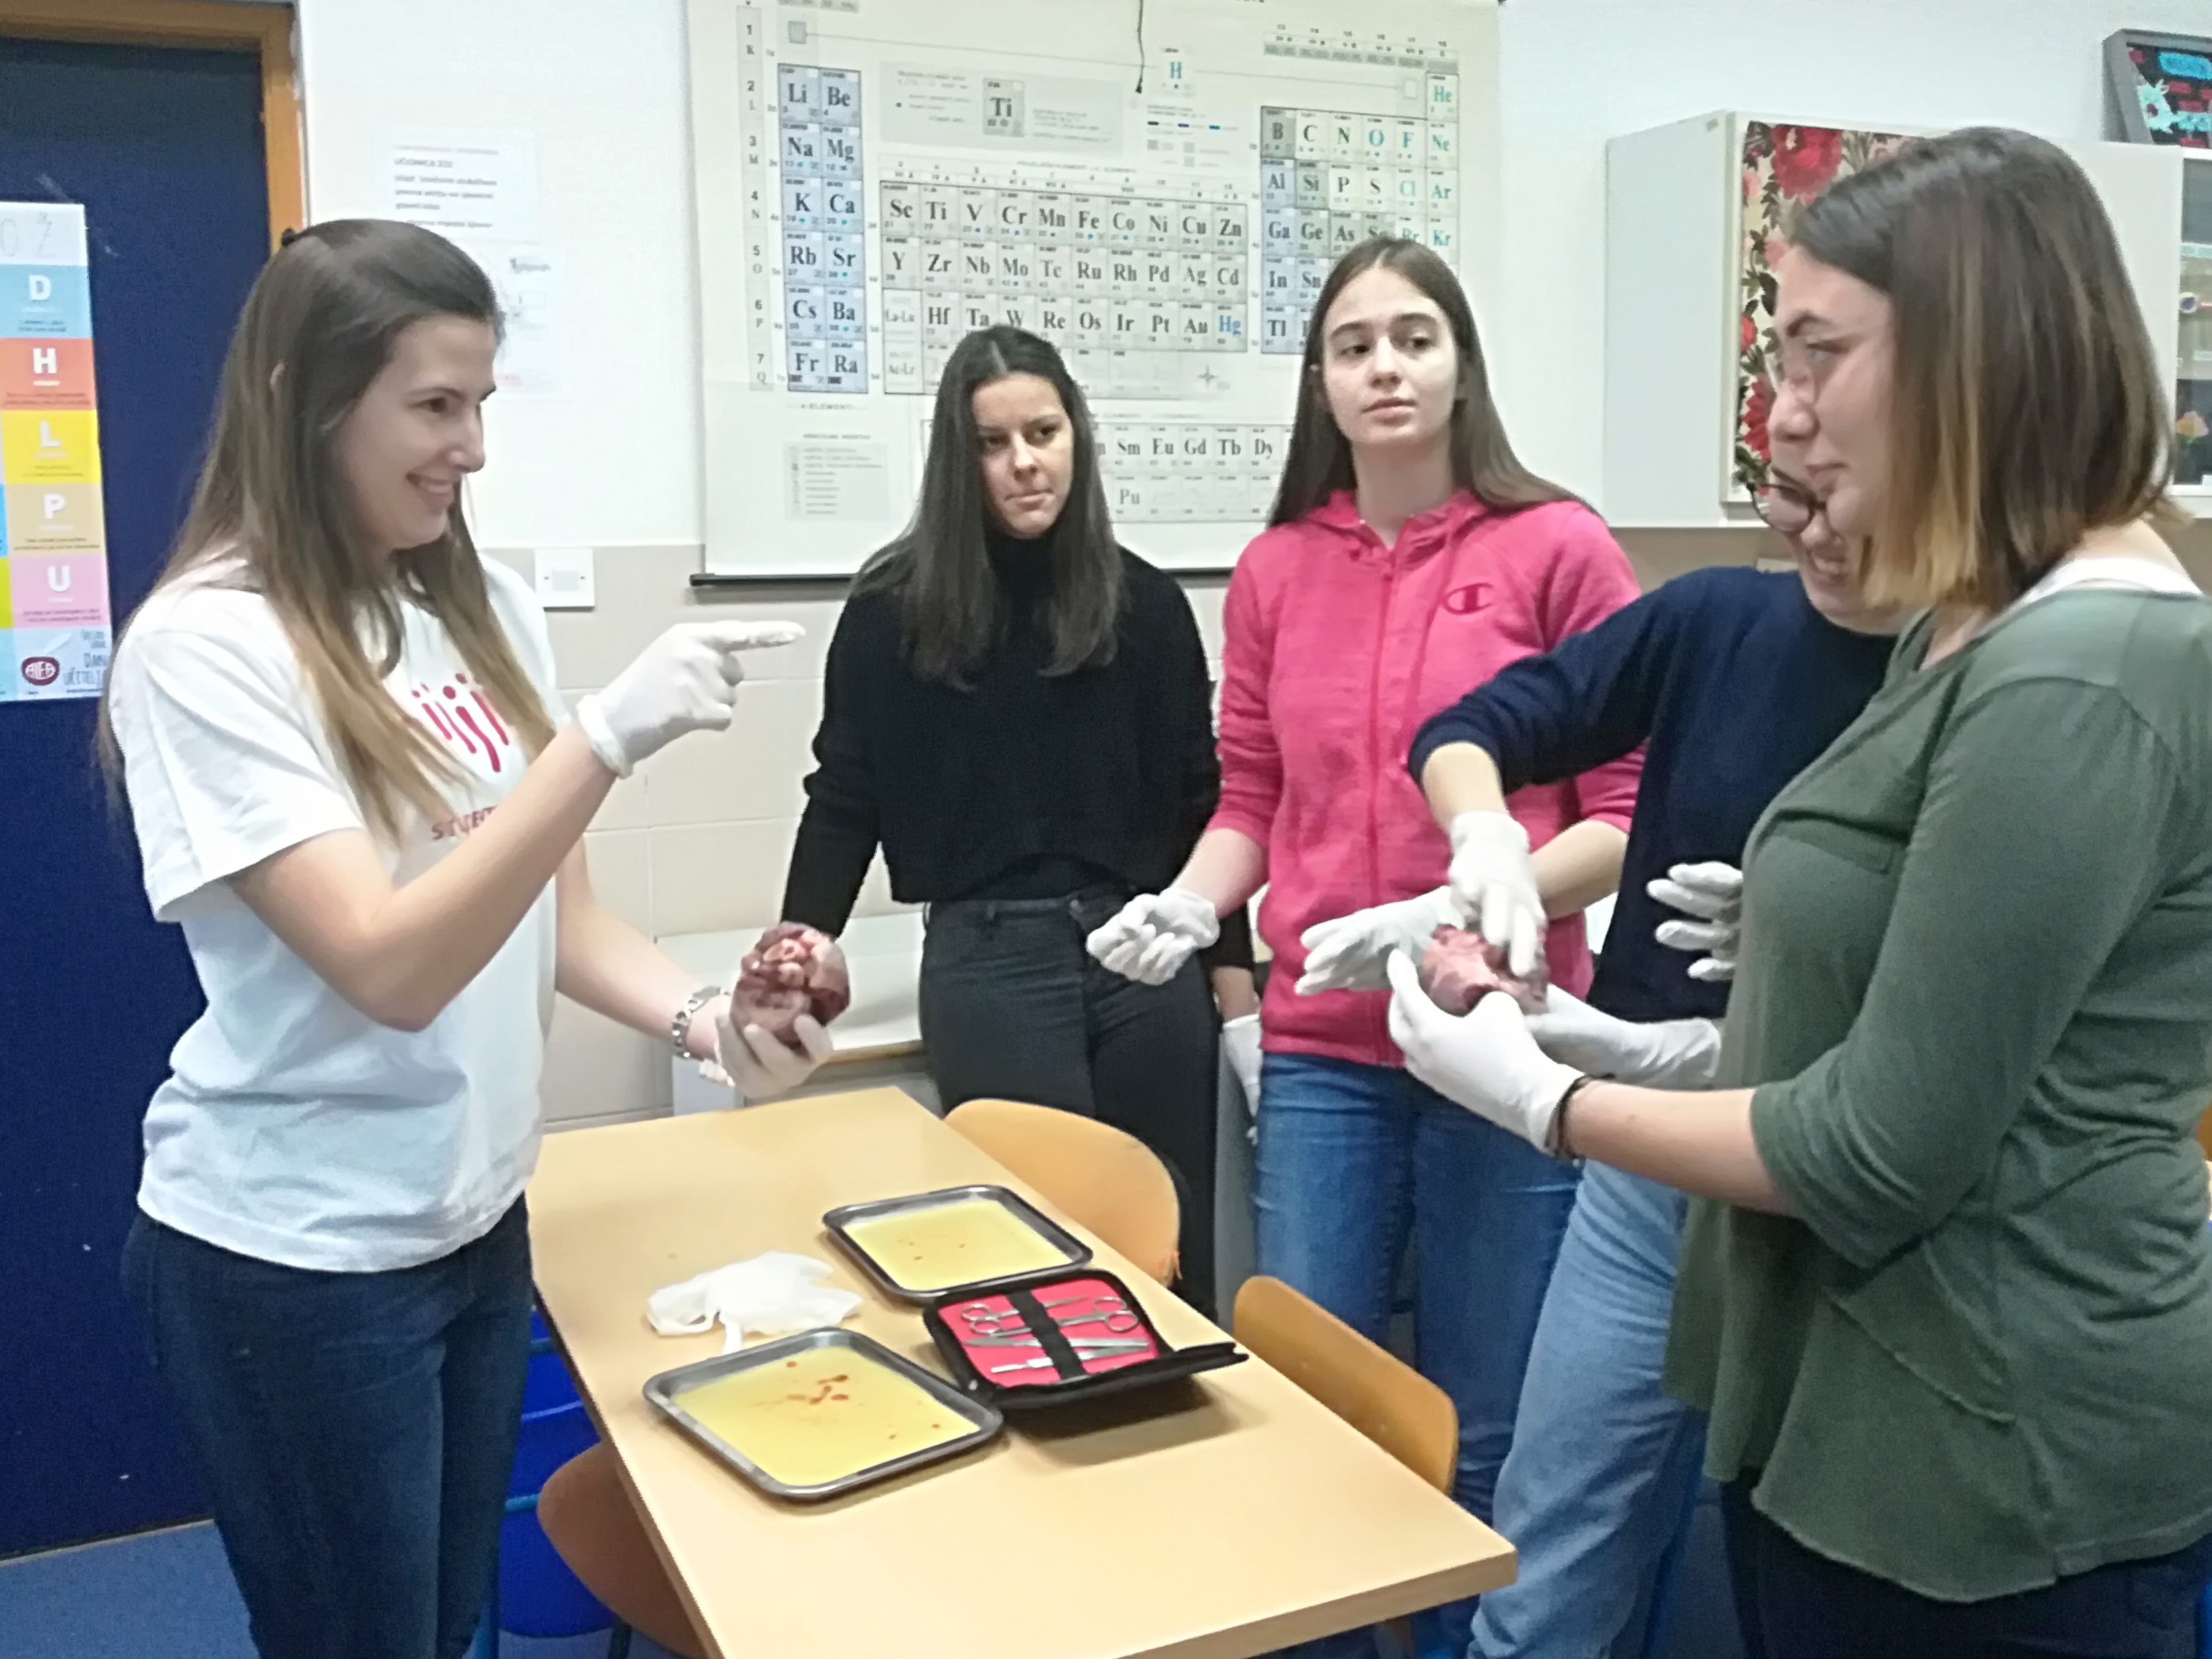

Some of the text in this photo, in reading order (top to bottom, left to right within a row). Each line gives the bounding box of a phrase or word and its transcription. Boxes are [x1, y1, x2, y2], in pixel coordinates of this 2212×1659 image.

[1170, 61, 1453, 102] H He
[787, 83, 851, 106] Li Be
[990, 97, 1012, 117] Ti
[1272, 123, 1450, 151] B C N O F Ne
[788, 137, 854, 163] Na Mg
[1268, 173, 1285, 190] Al
[1303, 174, 1319, 191] Si
[1337, 176, 1350, 192] P
[1370, 178, 1381, 194] S
[1432, 184, 1452, 198] Ar
[795, 192, 855, 213] K Ca
[889, 199, 1241, 237] Sc Ti V Cr Mn Fe Co Ni Cu Zn
[1268, 222, 1354, 241] Ga Ge As
[791, 246, 856, 267] Rb Sr
[892, 251, 1238, 287] Y Zr Nb Mo Tc Ru Rh Pd Ag Cd
[28, 275, 51, 300] D
[1270, 271, 1321, 288] In Sn
[793, 299, 855, 320] Cs Ba
[929, 307, 951, 325] Hf
[966, 308, 990, 327] Ta
[1006, 310, 1024, 327] W
[1043, 310, 1066, 329] Re
[1079, 312, 1102, 329] Os
[1117, 313, 1134, 332] Ir
[1152, 314, 1169, 333] Pt
[1184, 316, 1207, 333] Au
[1219, 315, 1241, 336] Hg
[1267, 320, 1286, 336] Tl
[32, 348, 58, 374] H
[795, 353, 858, 373] Fr Ra
[39, 421, 60, 447] L
[1118, 439, 1141, 455] Sm
[1153, 438, 1174, 455] Eu
[1184, 438, 1207, 455] Gd
[1218, 439, 1241, 455] Tb
[1255, 439, 1272, 459] Dy
[43, 494, 66, 519] P
[1119, 489, 1140, 504] Pu
[47, 566, 71, 591] U
